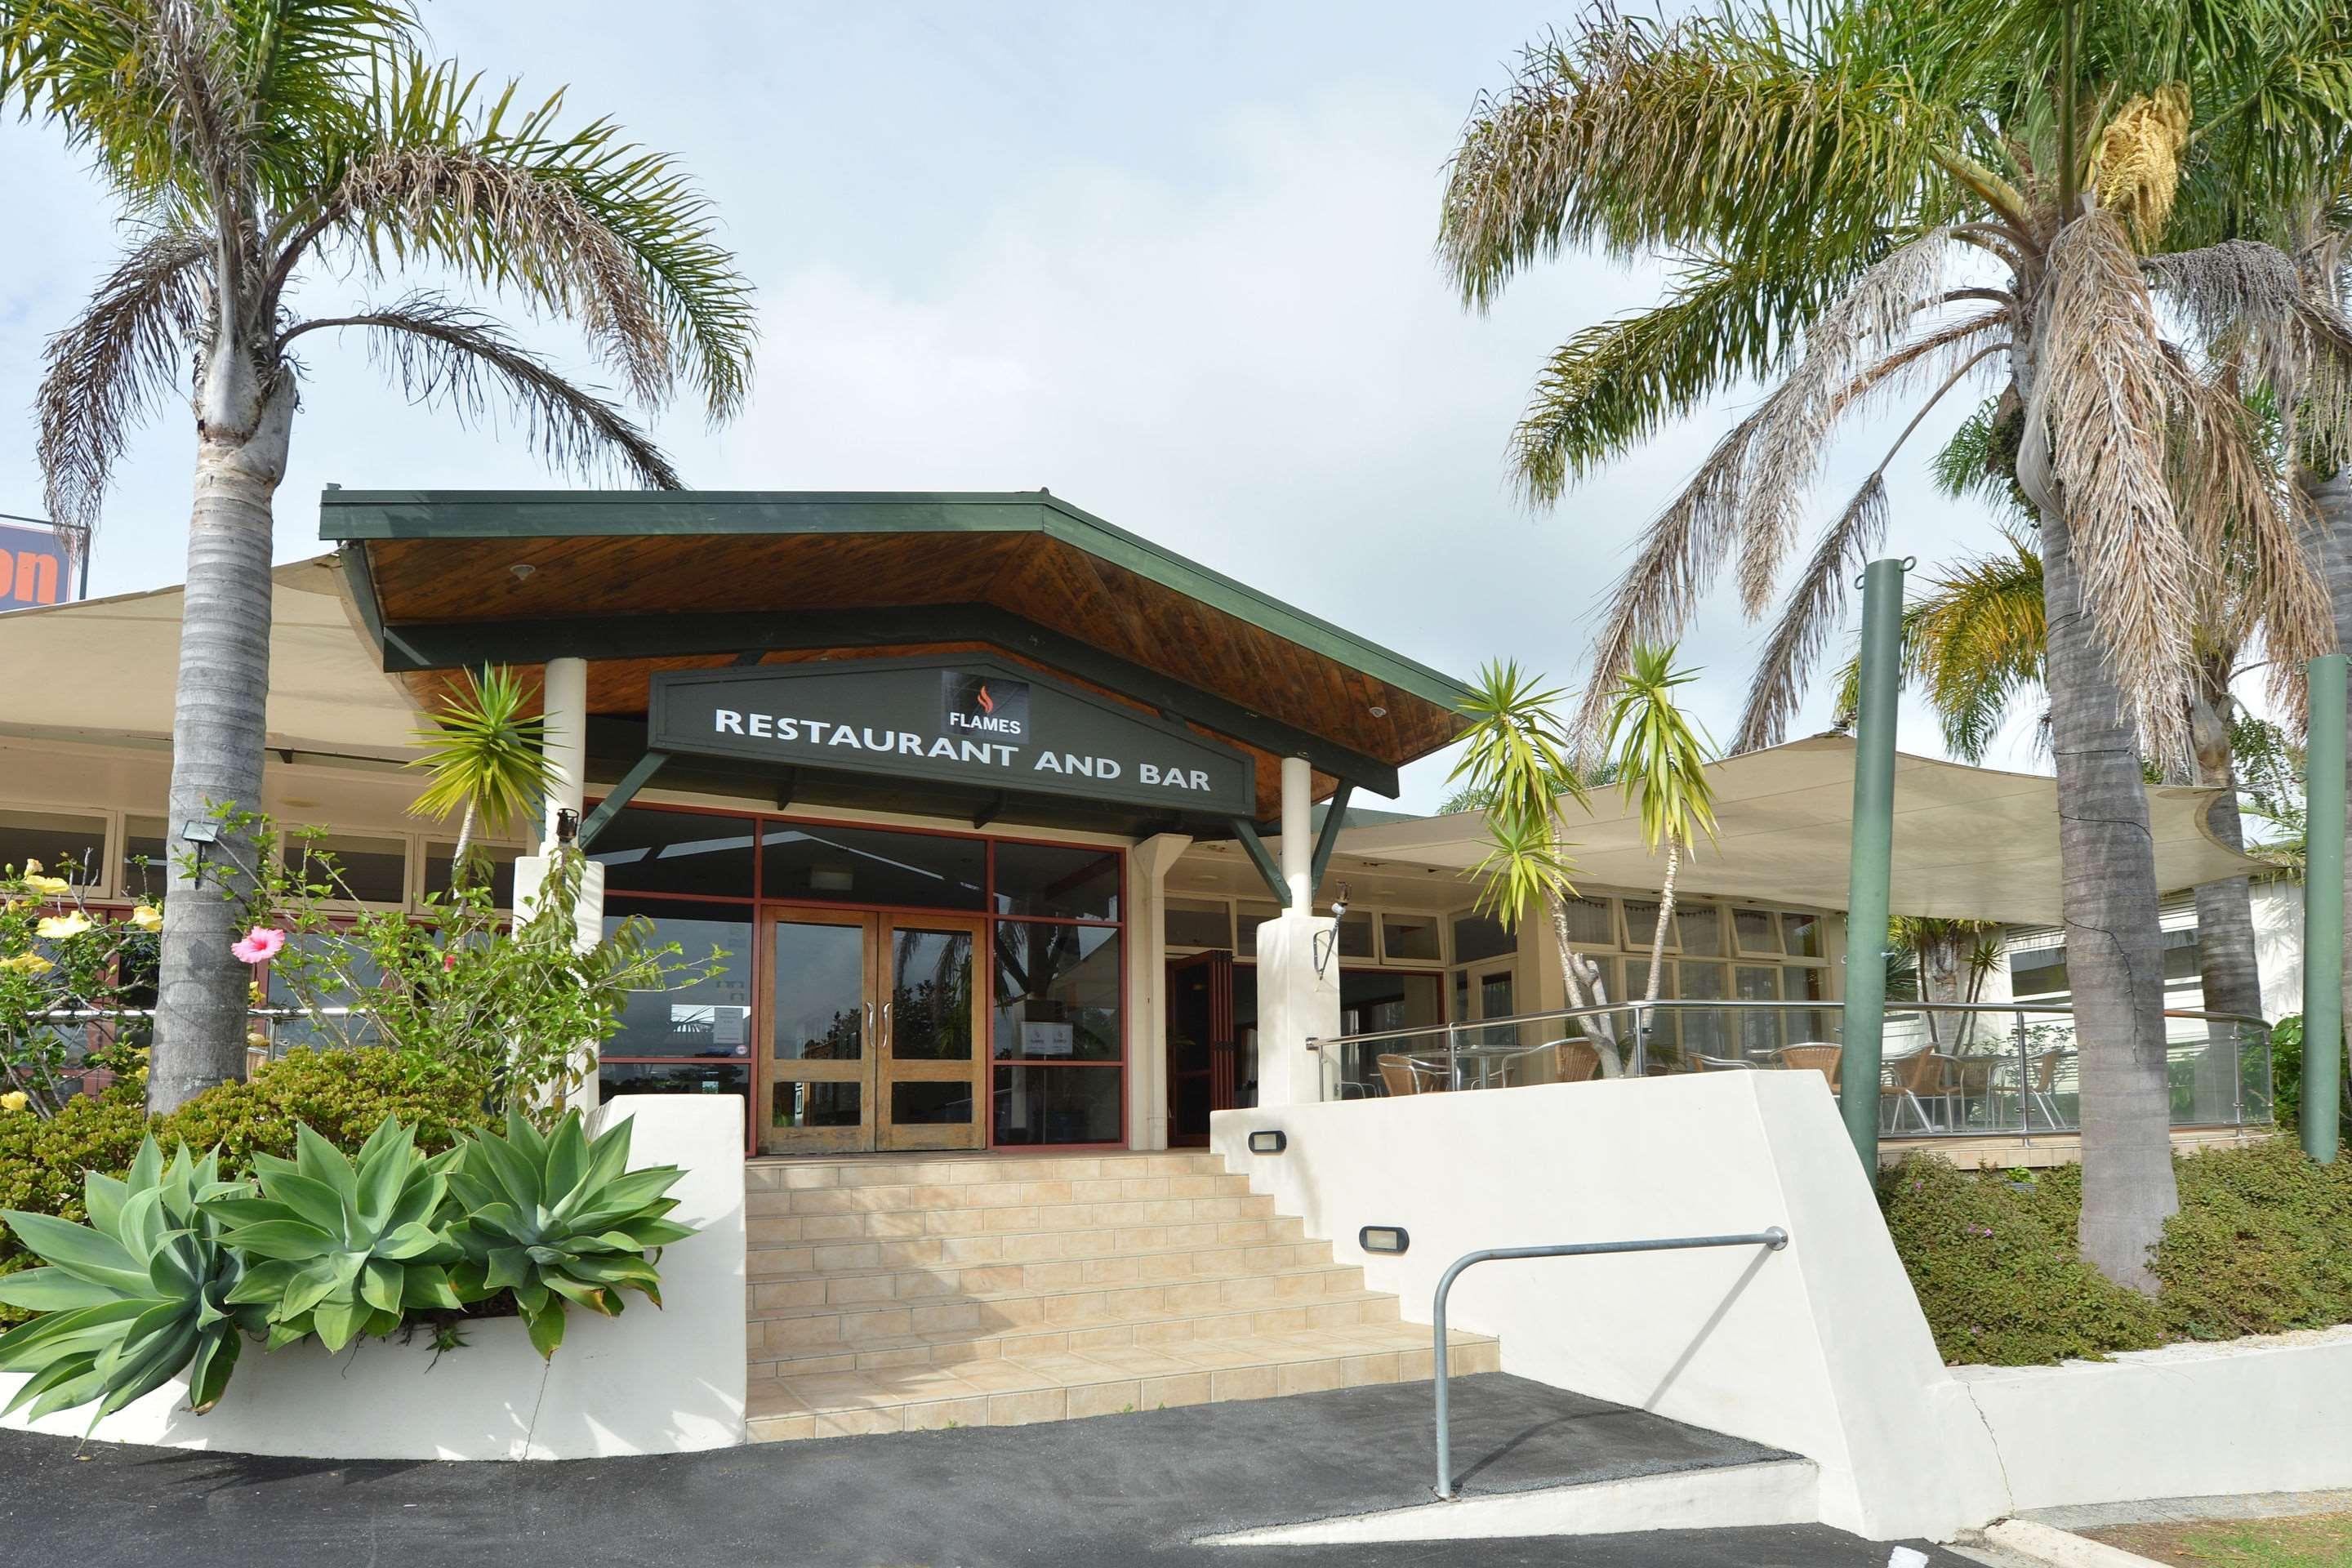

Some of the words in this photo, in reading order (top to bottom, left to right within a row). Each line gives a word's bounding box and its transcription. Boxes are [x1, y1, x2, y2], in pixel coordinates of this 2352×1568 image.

[950, 711, 1021, 734] FLAMES
[715, 709, 1019, 767] RESTAURANT
[1034, 751, 1121, 779] AND
[1140, 764, 1210, 791] BAR
